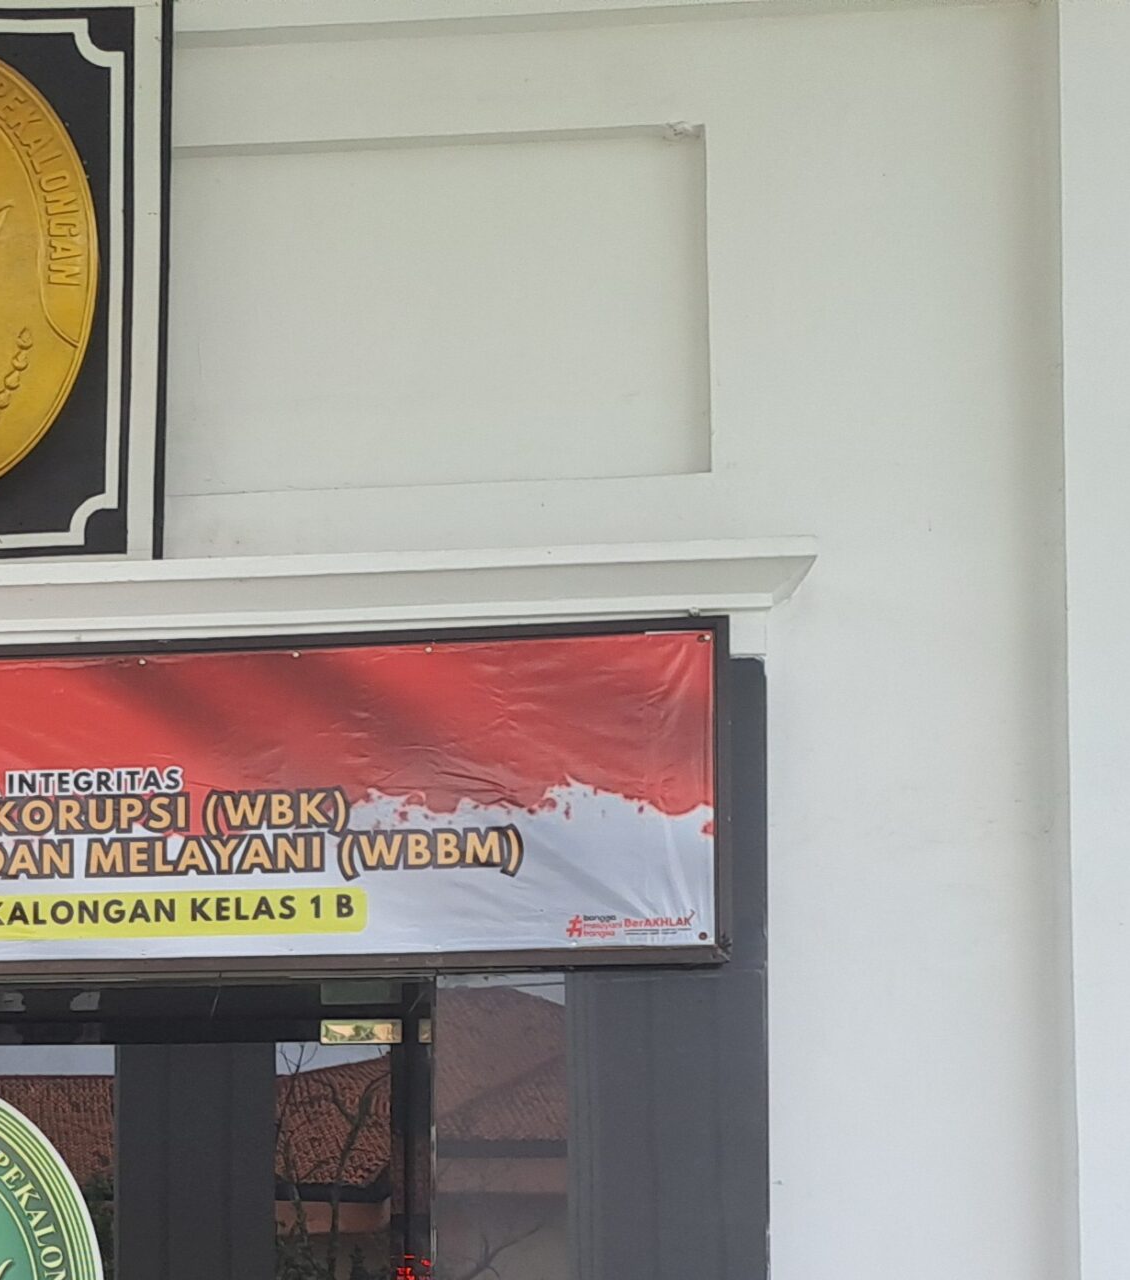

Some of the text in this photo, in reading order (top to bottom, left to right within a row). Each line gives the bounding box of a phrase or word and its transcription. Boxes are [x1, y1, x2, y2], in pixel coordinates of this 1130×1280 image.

[6, 767, 182, 797] INTEGRITAS
[205, 791, 349, 835] (WBK)
[89, 833, 323, 875] MELAYANI
[340, 826, 524, 878] (WBBM)
[190, 895, 297, 923] KELAS
[310, 895, 323, 920] 1
[336, 893, 355, 919] B
[624, 915, 692, 928] BerAKHLAK
